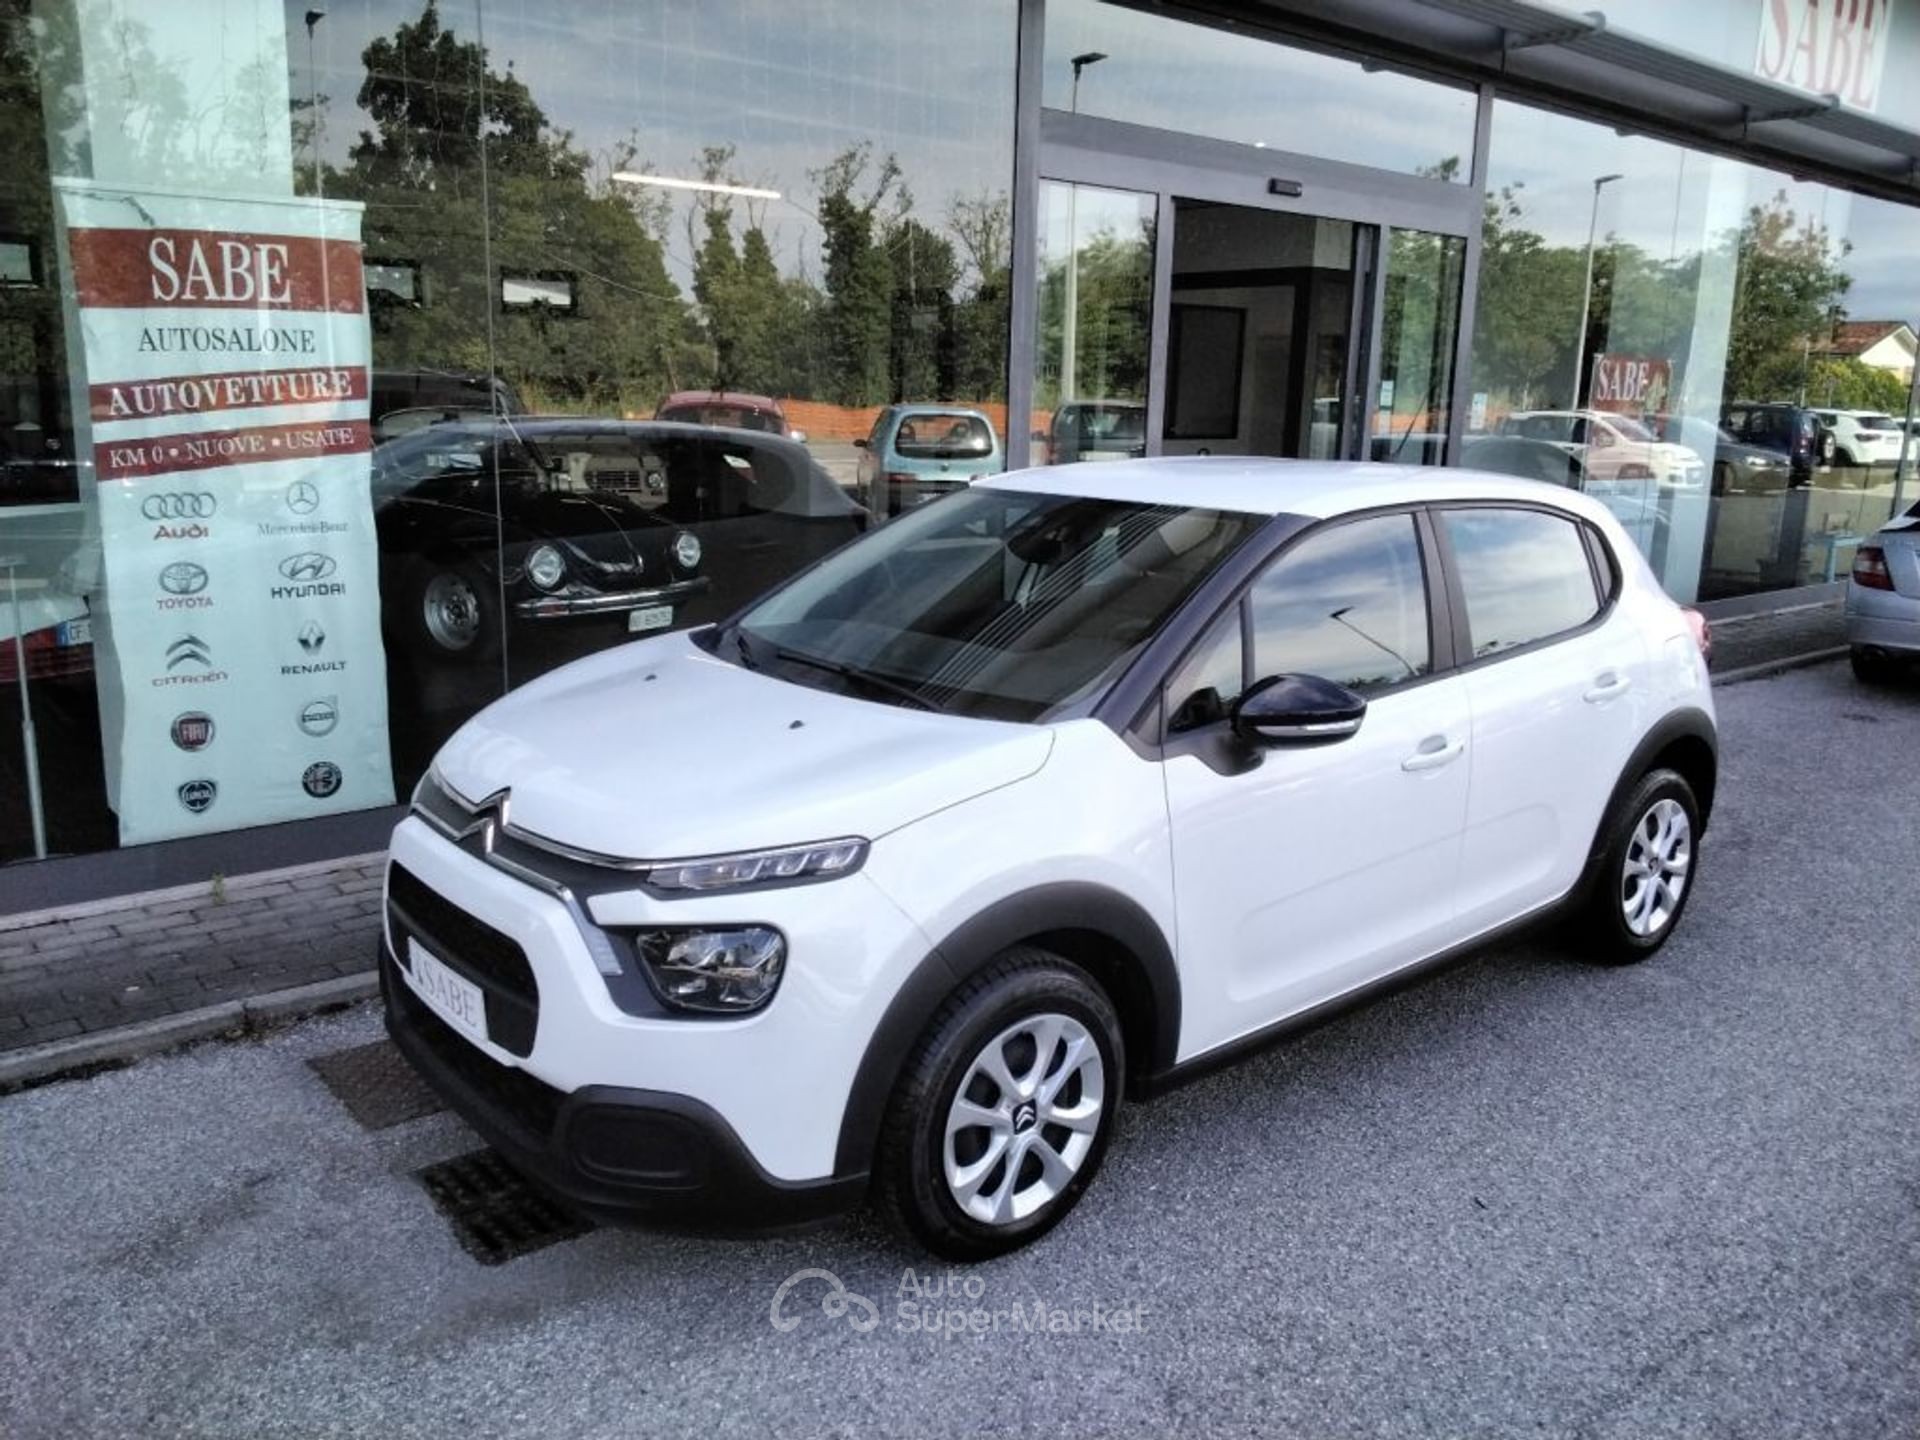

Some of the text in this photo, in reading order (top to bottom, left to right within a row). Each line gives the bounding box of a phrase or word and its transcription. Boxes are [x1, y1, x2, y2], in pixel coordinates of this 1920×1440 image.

[149, 236, 292, 303] SABE
[138, 327, 316, 353] AUTOSALONE
[1597, 358, 1649, 401] SABE
[107, 370, 353, 416] AUTOVETTURE
[109, 427, 354, 468] KM 0 NUOVE USATE
[153, 523, 209, 541] Audi
[156, 596, 214, 610] TOYOTA
[270, 583, 346, 600] HYUNDAI
[281, 660, 347, 675] RENAULT
